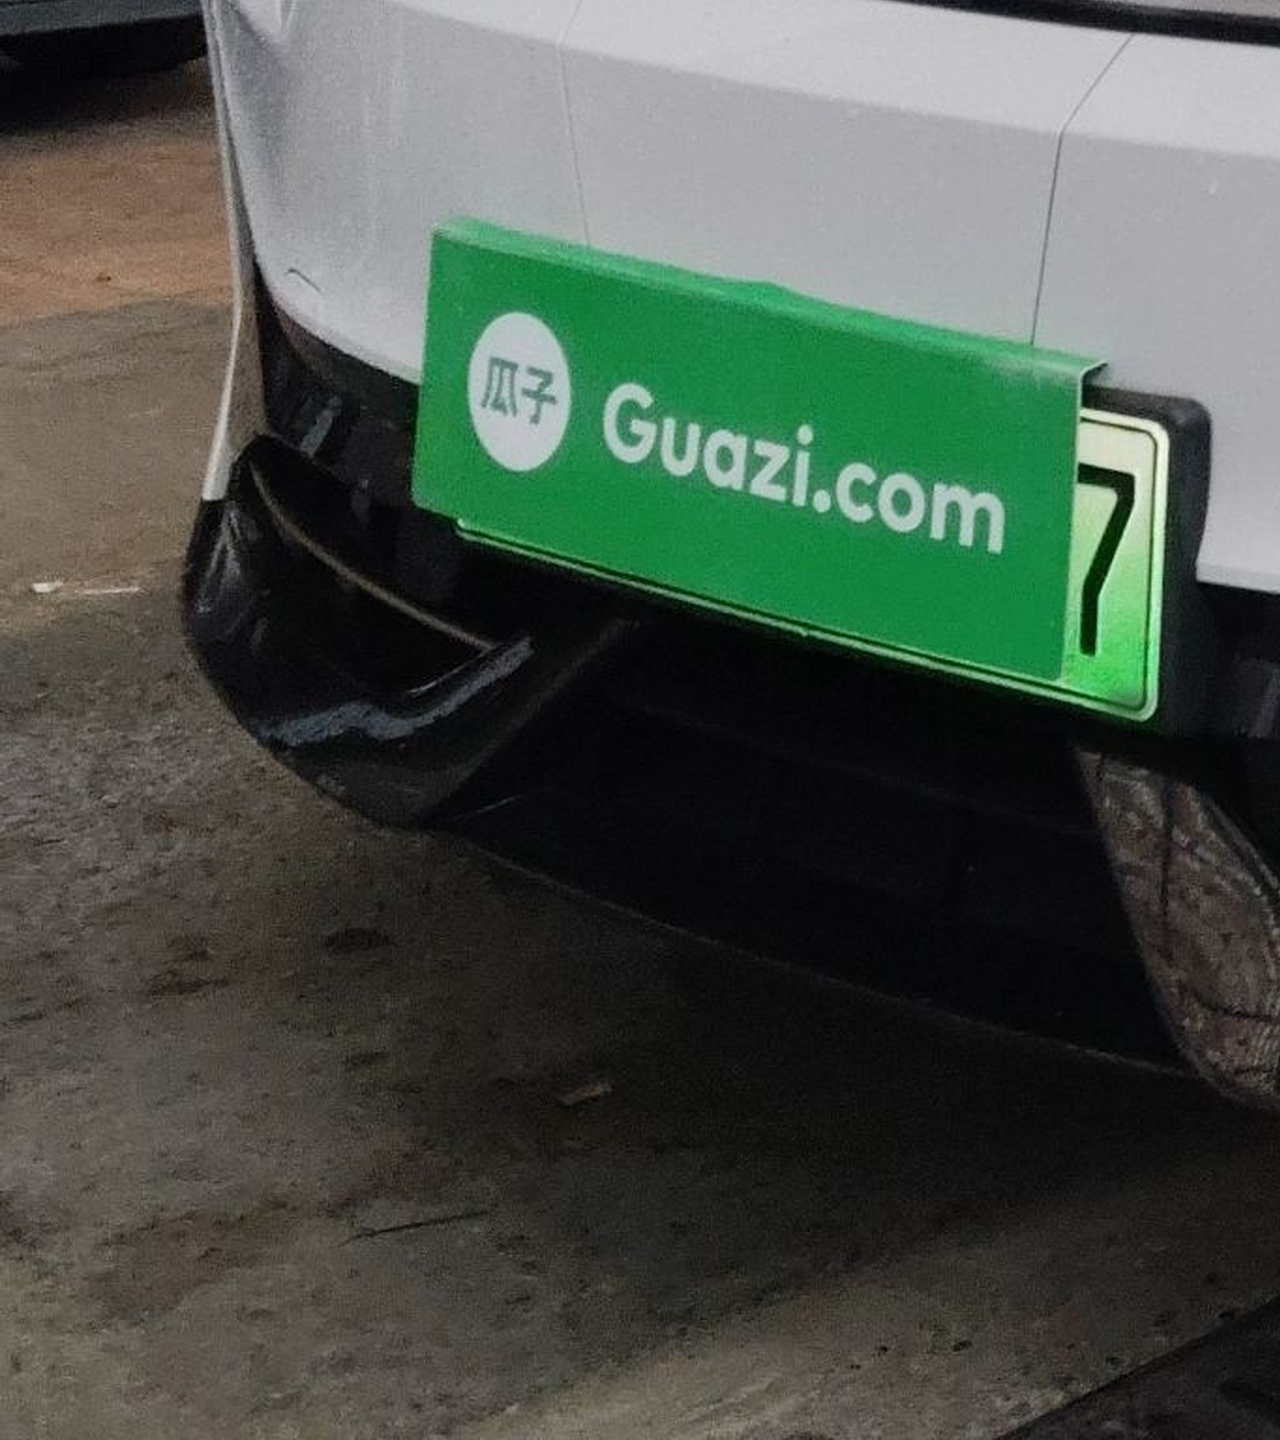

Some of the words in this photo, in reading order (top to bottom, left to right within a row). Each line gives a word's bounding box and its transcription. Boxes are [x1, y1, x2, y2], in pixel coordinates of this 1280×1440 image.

[481, 356, 557, 424] 瓜子
[603, 381, 1006, 555] Guazi.com
[1076, 462, 1136, 658] 7
